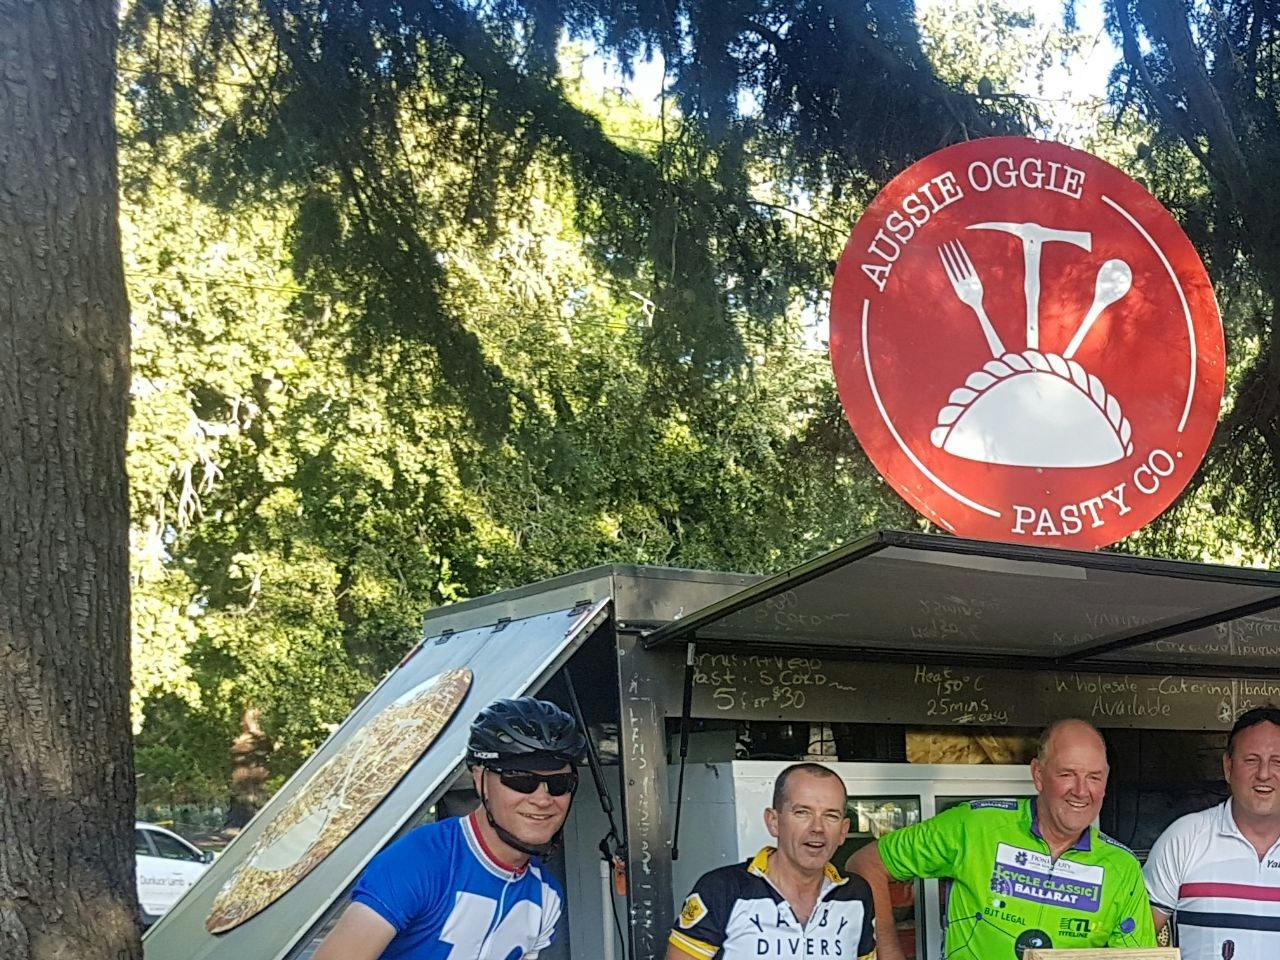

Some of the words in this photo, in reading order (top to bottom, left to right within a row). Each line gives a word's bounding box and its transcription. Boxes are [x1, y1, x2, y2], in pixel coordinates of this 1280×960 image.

[860, 171, 964, 293] AUSSIE
[967, 156, 1087, 200] OGGIE
[1010, 482, 1132, 537] PASTY
[1133, 447, 1184, 496] CO.
[1002, 870, 1041, 887] CYCLE
[1042, 879, 1094, 897] CLASSIC
[1014, 883, 1079, 904] BALLARAT
[749, 908, 849, 936] YABY
[984, 907, 1000, 918] BJT
[1001, 911, 1027, 926] LEGAL
[1058, 930, 1089, 939] TITELINE
[757, 938, 843, 956] DIVERS
